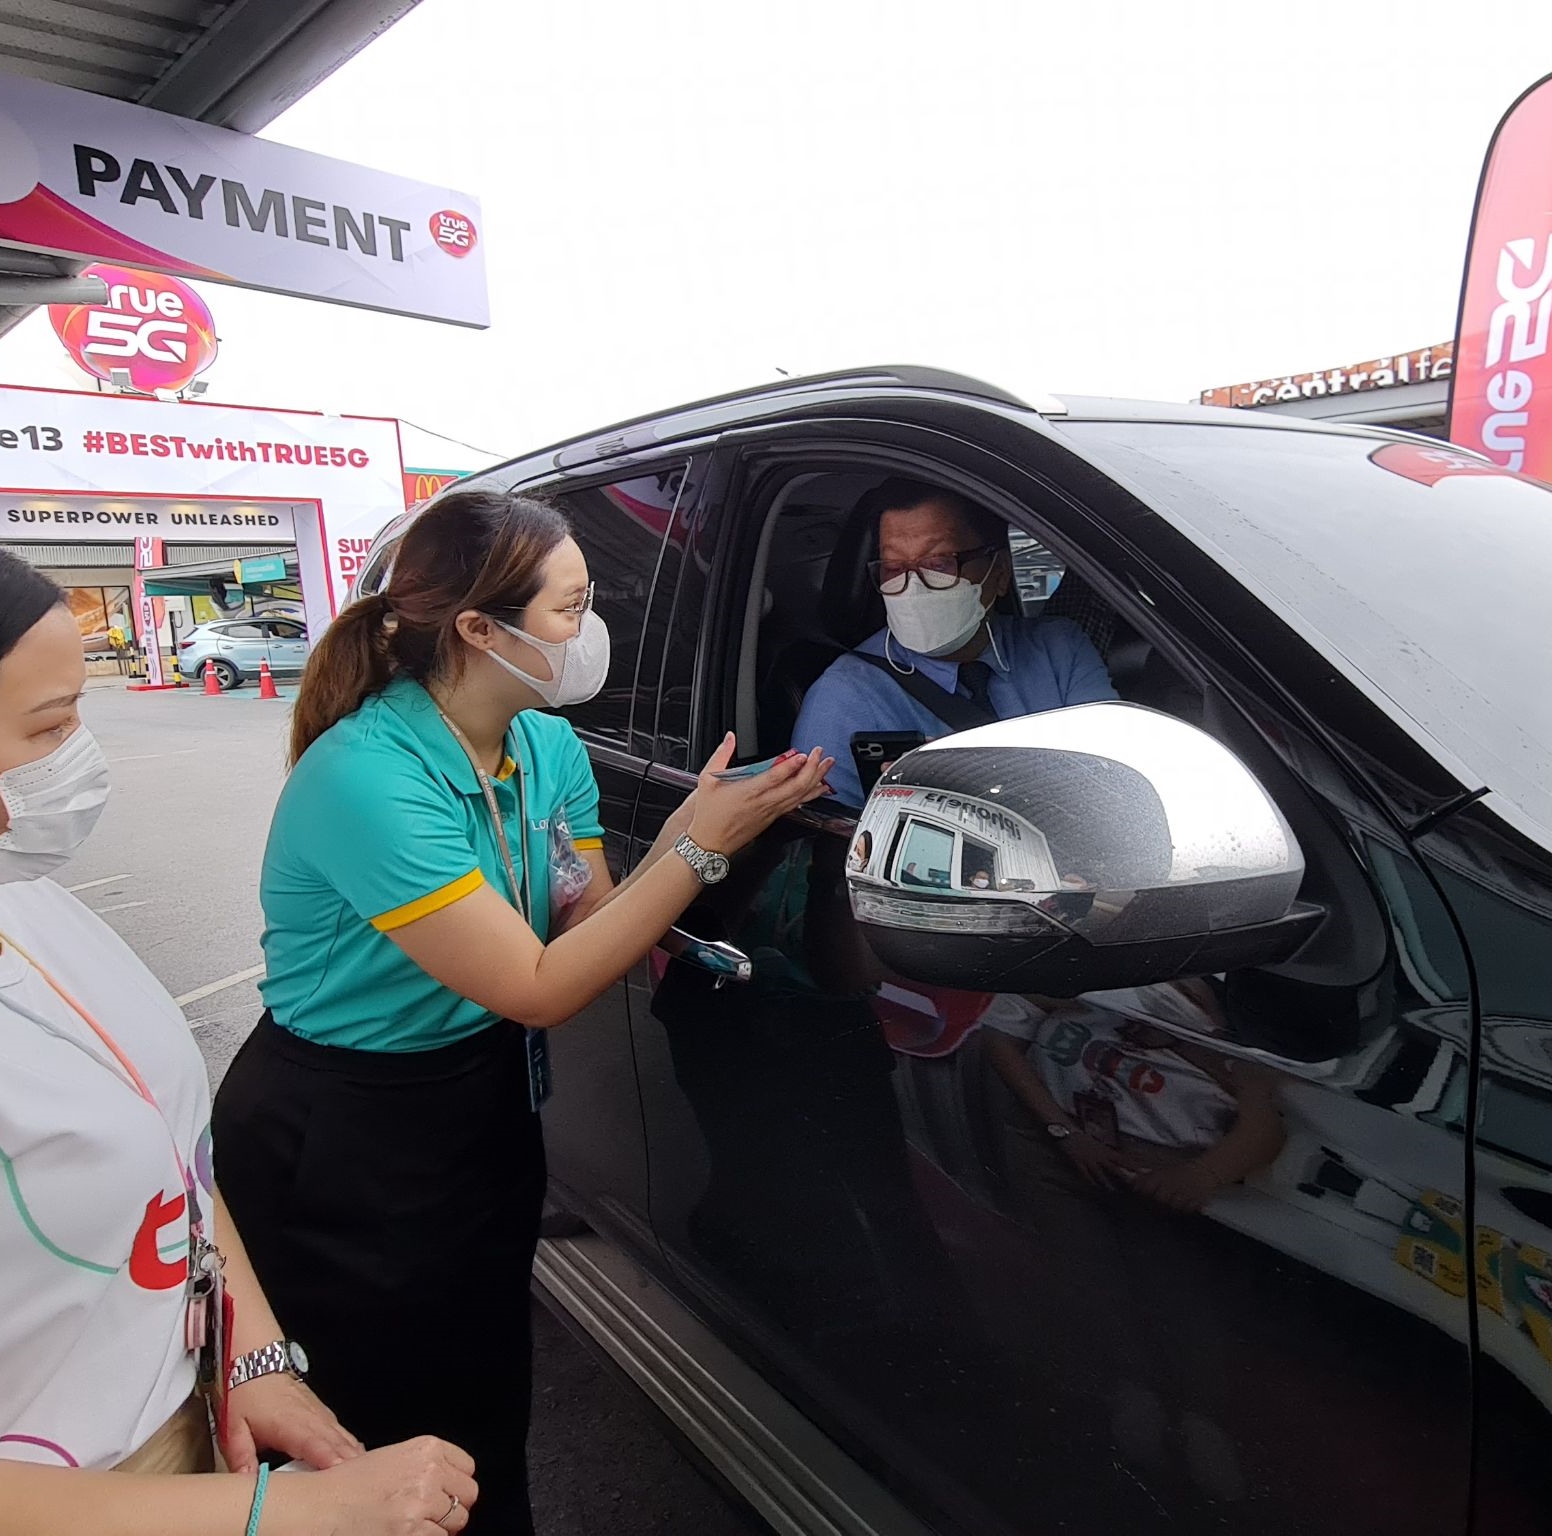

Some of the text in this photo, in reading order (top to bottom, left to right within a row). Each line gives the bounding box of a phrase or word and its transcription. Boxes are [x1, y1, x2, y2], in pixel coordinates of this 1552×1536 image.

[71, 143, 412, 263] PAYMENT
[438, 225, 469, 247] 5G
[439, 213, 468, 231] true
[83, 313, 189, 364] 5G
[83, 431, 370, 469] #BESTwithTRUE5G
[7, 508, 280, 529] SUPERPOWER UNLEASHED
